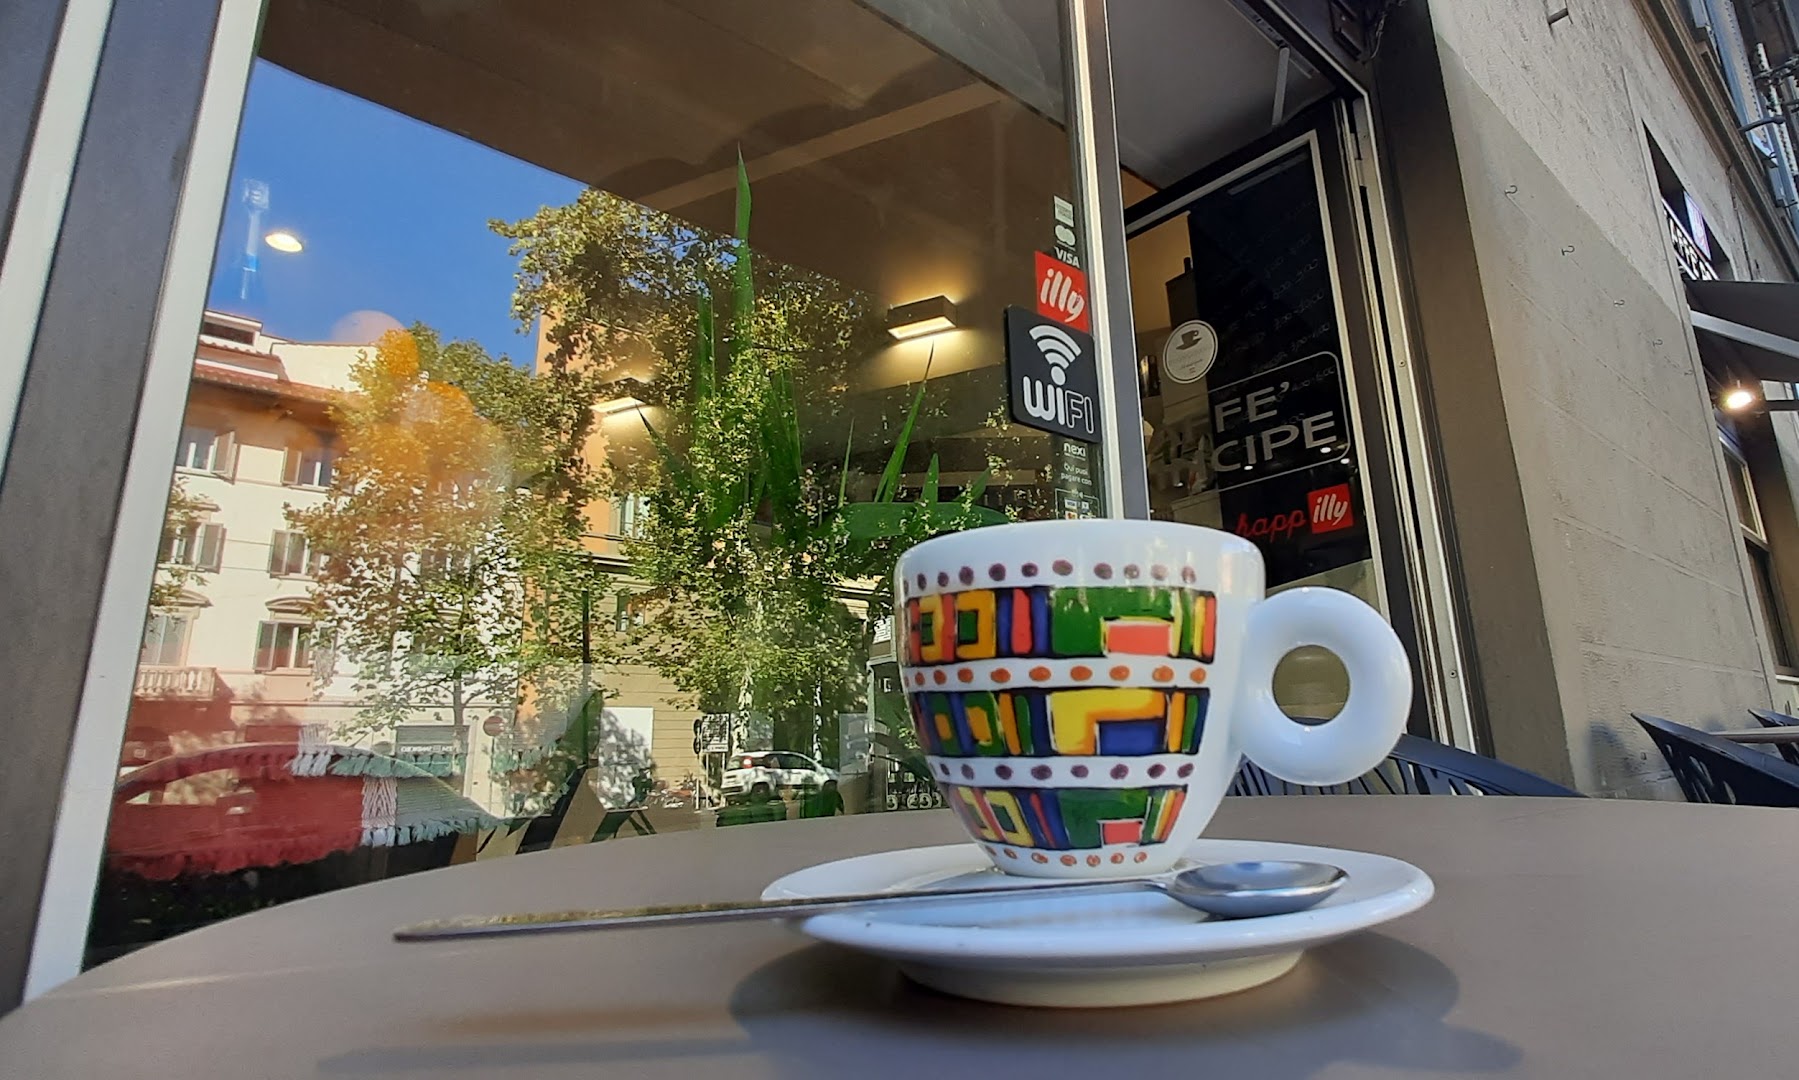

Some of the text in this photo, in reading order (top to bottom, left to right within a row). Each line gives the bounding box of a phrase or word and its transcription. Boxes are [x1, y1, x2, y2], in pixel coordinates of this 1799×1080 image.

[1053, 245, 1080, 268] VISA
[1040, 268, 1085, 322] illy
[1063, 442, 1086, 457] nexi
[1211, 411, 1337, 472] CIPE
[1235, 493, 1348, 543] happ illy
